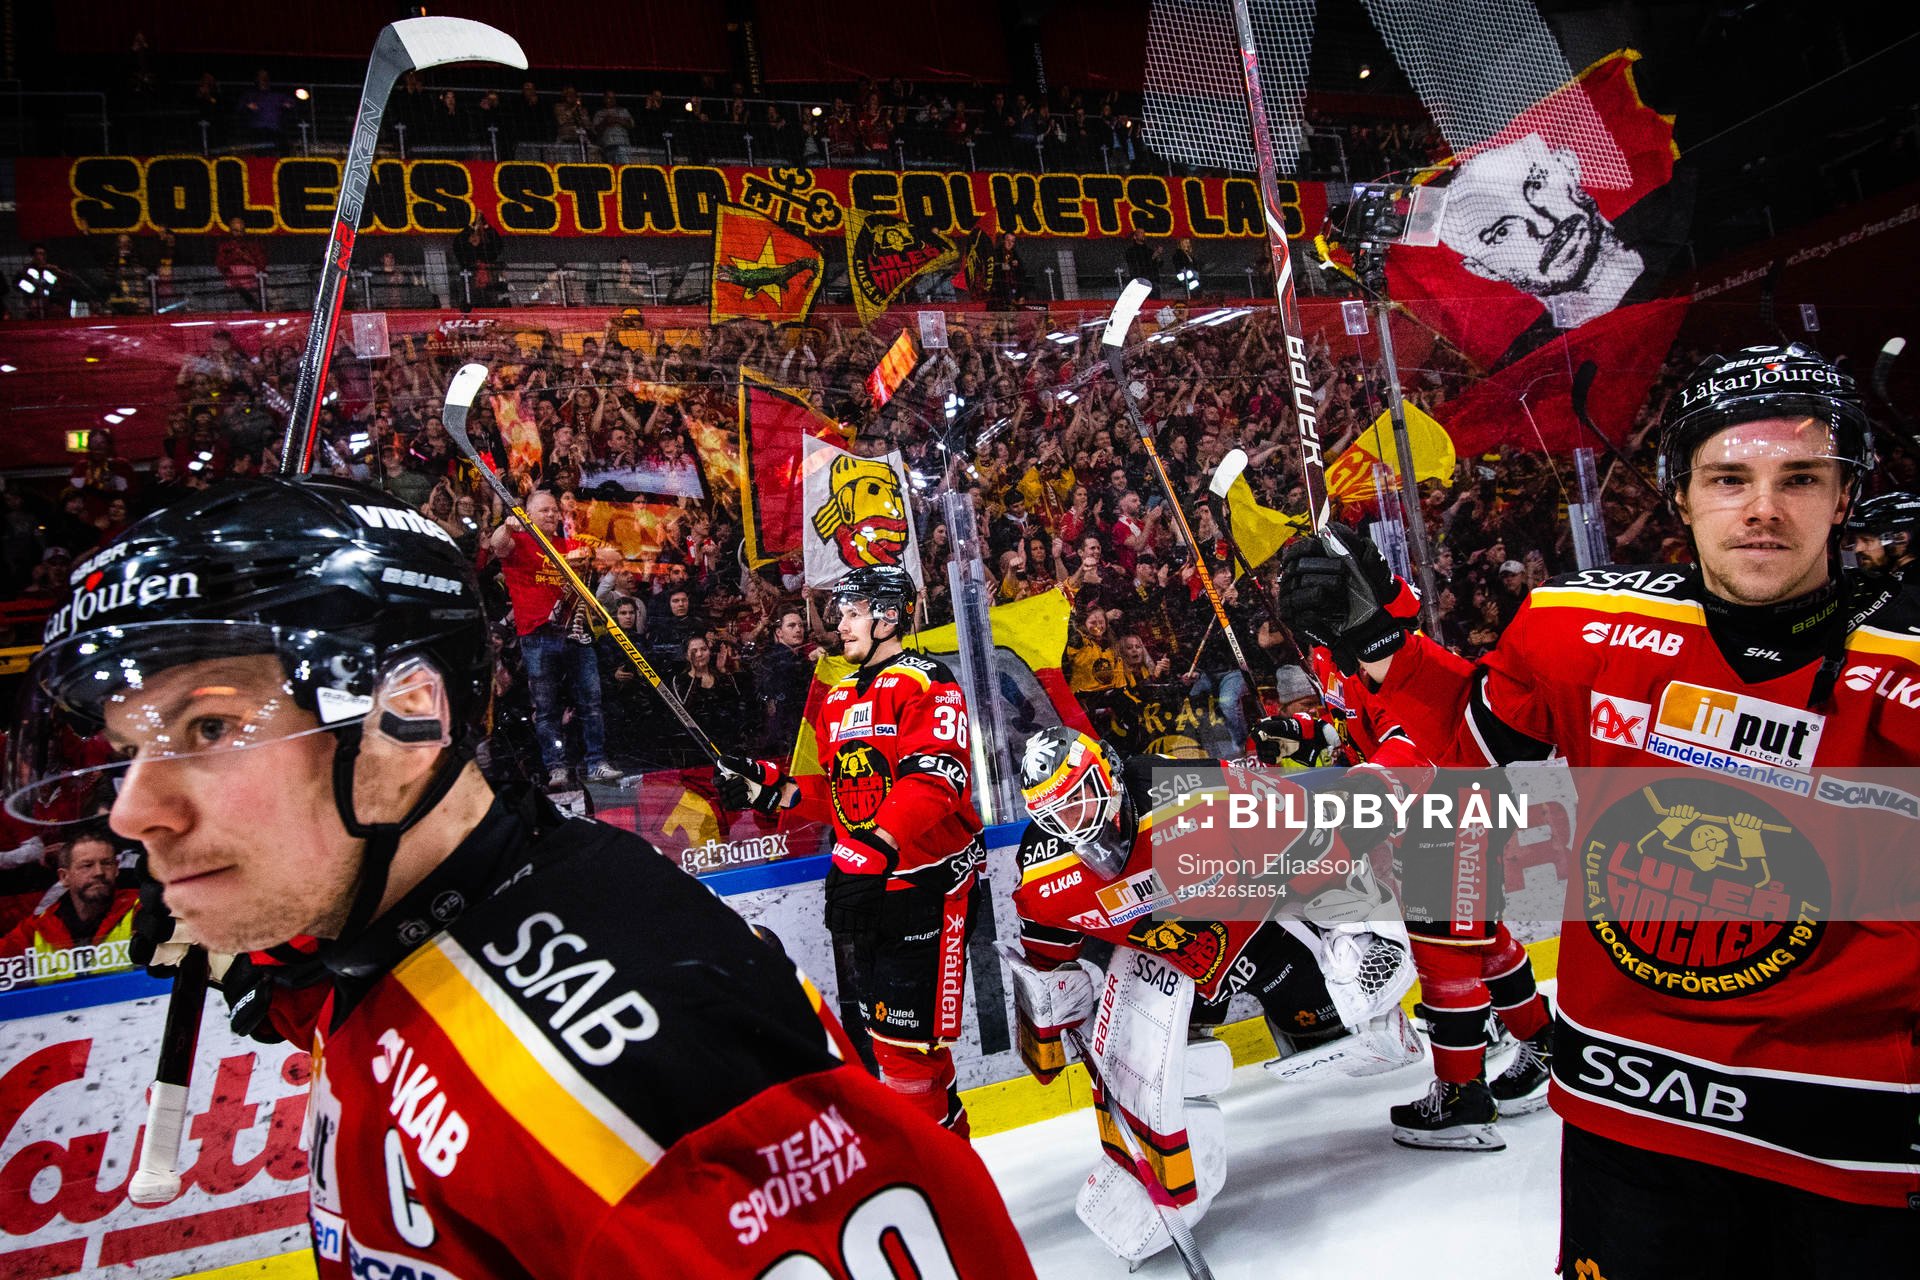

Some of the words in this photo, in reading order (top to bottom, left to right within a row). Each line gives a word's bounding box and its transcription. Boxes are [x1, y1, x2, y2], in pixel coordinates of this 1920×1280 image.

[494, 161, 731, 234] STAD
[1717, 354, 1788, 374] BAUER
[1680, 367, 1841, 408] LäkarJouren
[381, 567, 463, 596] BAUER
[1565, 570, 1685, 593] SSAB
[1609, 626, 1684, 657] LKAB
[1744, 647, 1783, 663] SHL
[932, 705, 968, 749] 36
[1692, 697, 1810, 761] input
[1647, 735, 1811, 796] Handelsbanken
[1743, 745, 1800, 769] interiör
[1148, 774, 1203, 806] SSAB
[1818, 780, 1920, 817] SCANIA
[681, 838, 790, 876] gainomax
[1585, 840, 1607, 909] LULEÅ
[1051, 871, 1083, 894] LKAB
[1114, 873, 1163, 907] input
[1608, 841, 1791, 923] LULEÅ
[1110, 896, 1176, 926] Handelsbanken
[1606, 874, 1784, 968] HOCKEY
[1789, 900, 1820, 948] 1977
[0, 943, 129, 988] gainomax
[1133, 953, 1179, 997] SSAB
[1591, 913, 1797, 994] HOCKEYFÖRENING
[482, 912, 660, 1066] SSAB
[1262, 963, 1294, 993] BAUER
[887, 1016, 920, 1028] Energi
[888, 1008, 915, 1018] Luleå
[1094, 973, 1119, 1057] BAUER
[1579, 1044, 1748, 1122] SSAB
[390, 1046, 470, 1178] LKAB
[756, 1103, 855, 1174] TEAM
[728, 1137, 868, 1246] SPORTIA
